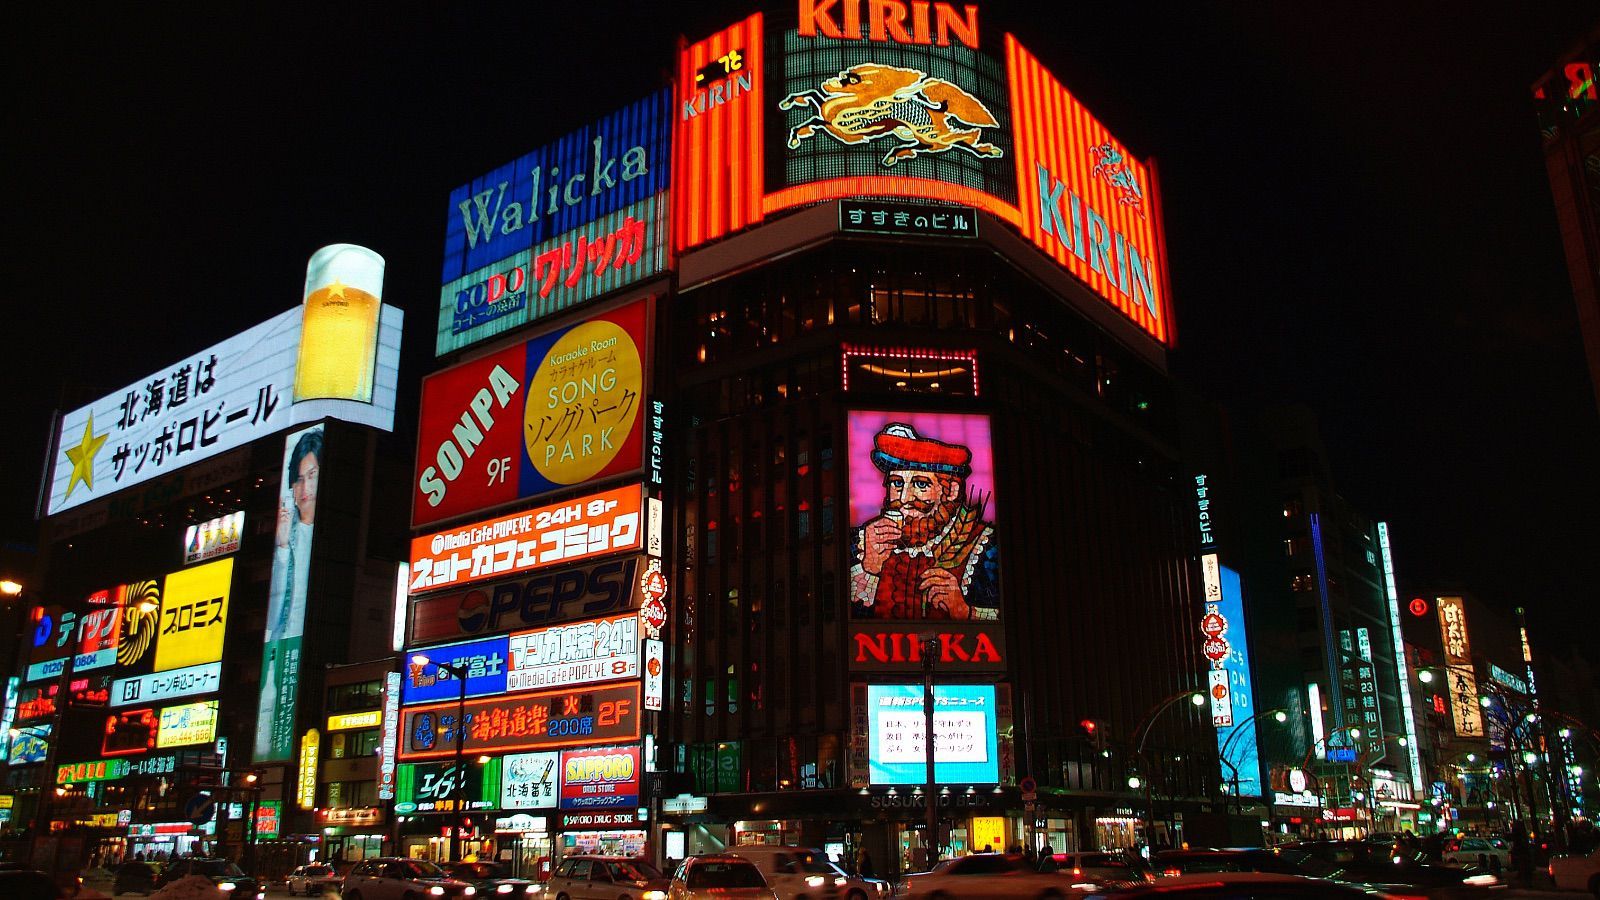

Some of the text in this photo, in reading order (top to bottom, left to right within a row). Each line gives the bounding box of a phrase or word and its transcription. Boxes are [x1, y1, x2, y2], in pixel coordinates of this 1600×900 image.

[798, 0, 979, 49] KIRIN
[682, 70, 753, 121] KIRIN
[458, 136, 649, 250] Walicka
[848, 208, 968, 231] すすきのビル
[535, 216, 646, 299] ワリッカ
[1036, 161, 1157, 320] KIRIN
[455, 267, 525, 315] GODO
[550, 336, 617, 367] Karaoke Room
[550, 350, 617, 383] カラオケルーム
[117, 354, 218, 431] 北海道は
[548, 368, 617, 409] SONG
[111, 384, 280, 483] サッポロビール
[419, 364, 521, 507] SONPA
[528, 388, 637, 448] ソングパーク
[545, 426, 614, 467] PARK
[651, 400, 664, 484] すすきのビル
[487, 457, 512, 487] 9F
[471, 526, 493, 545] Cafe
[493, 514, 533, 538] POPEYE
[535, 504, 582, 529] 24H
[586, 499, 618, 517] 8F
[488, 558, 639, 630] PEPSI
[163, 597, 225, 635] プロミス
[152, 672, 217, 694] ローン申込コーナー
[546, 667, 567, 683] Cafe
[568, 662, 607, 681] POPEYE
[612, 661, 636, 675] 8F
[125, 681, 140, 699] B1
[646, 696, 660, 707] 4F
[548, 716, 594, 737] 200席
[597, 699, 632, 727] 2F
[913, 745, 973, 753] 女カーリング
[566, 755, 635, 783] SAPPORO
[507, 781, 553, 798] 北海番屋
[583, 784, 615, 794] DRUG STORE
[871, 796, 949, 808] SUSUKO
[594, 814, 611, 824] DRUG
[613, 814, 634, 823] STORE
